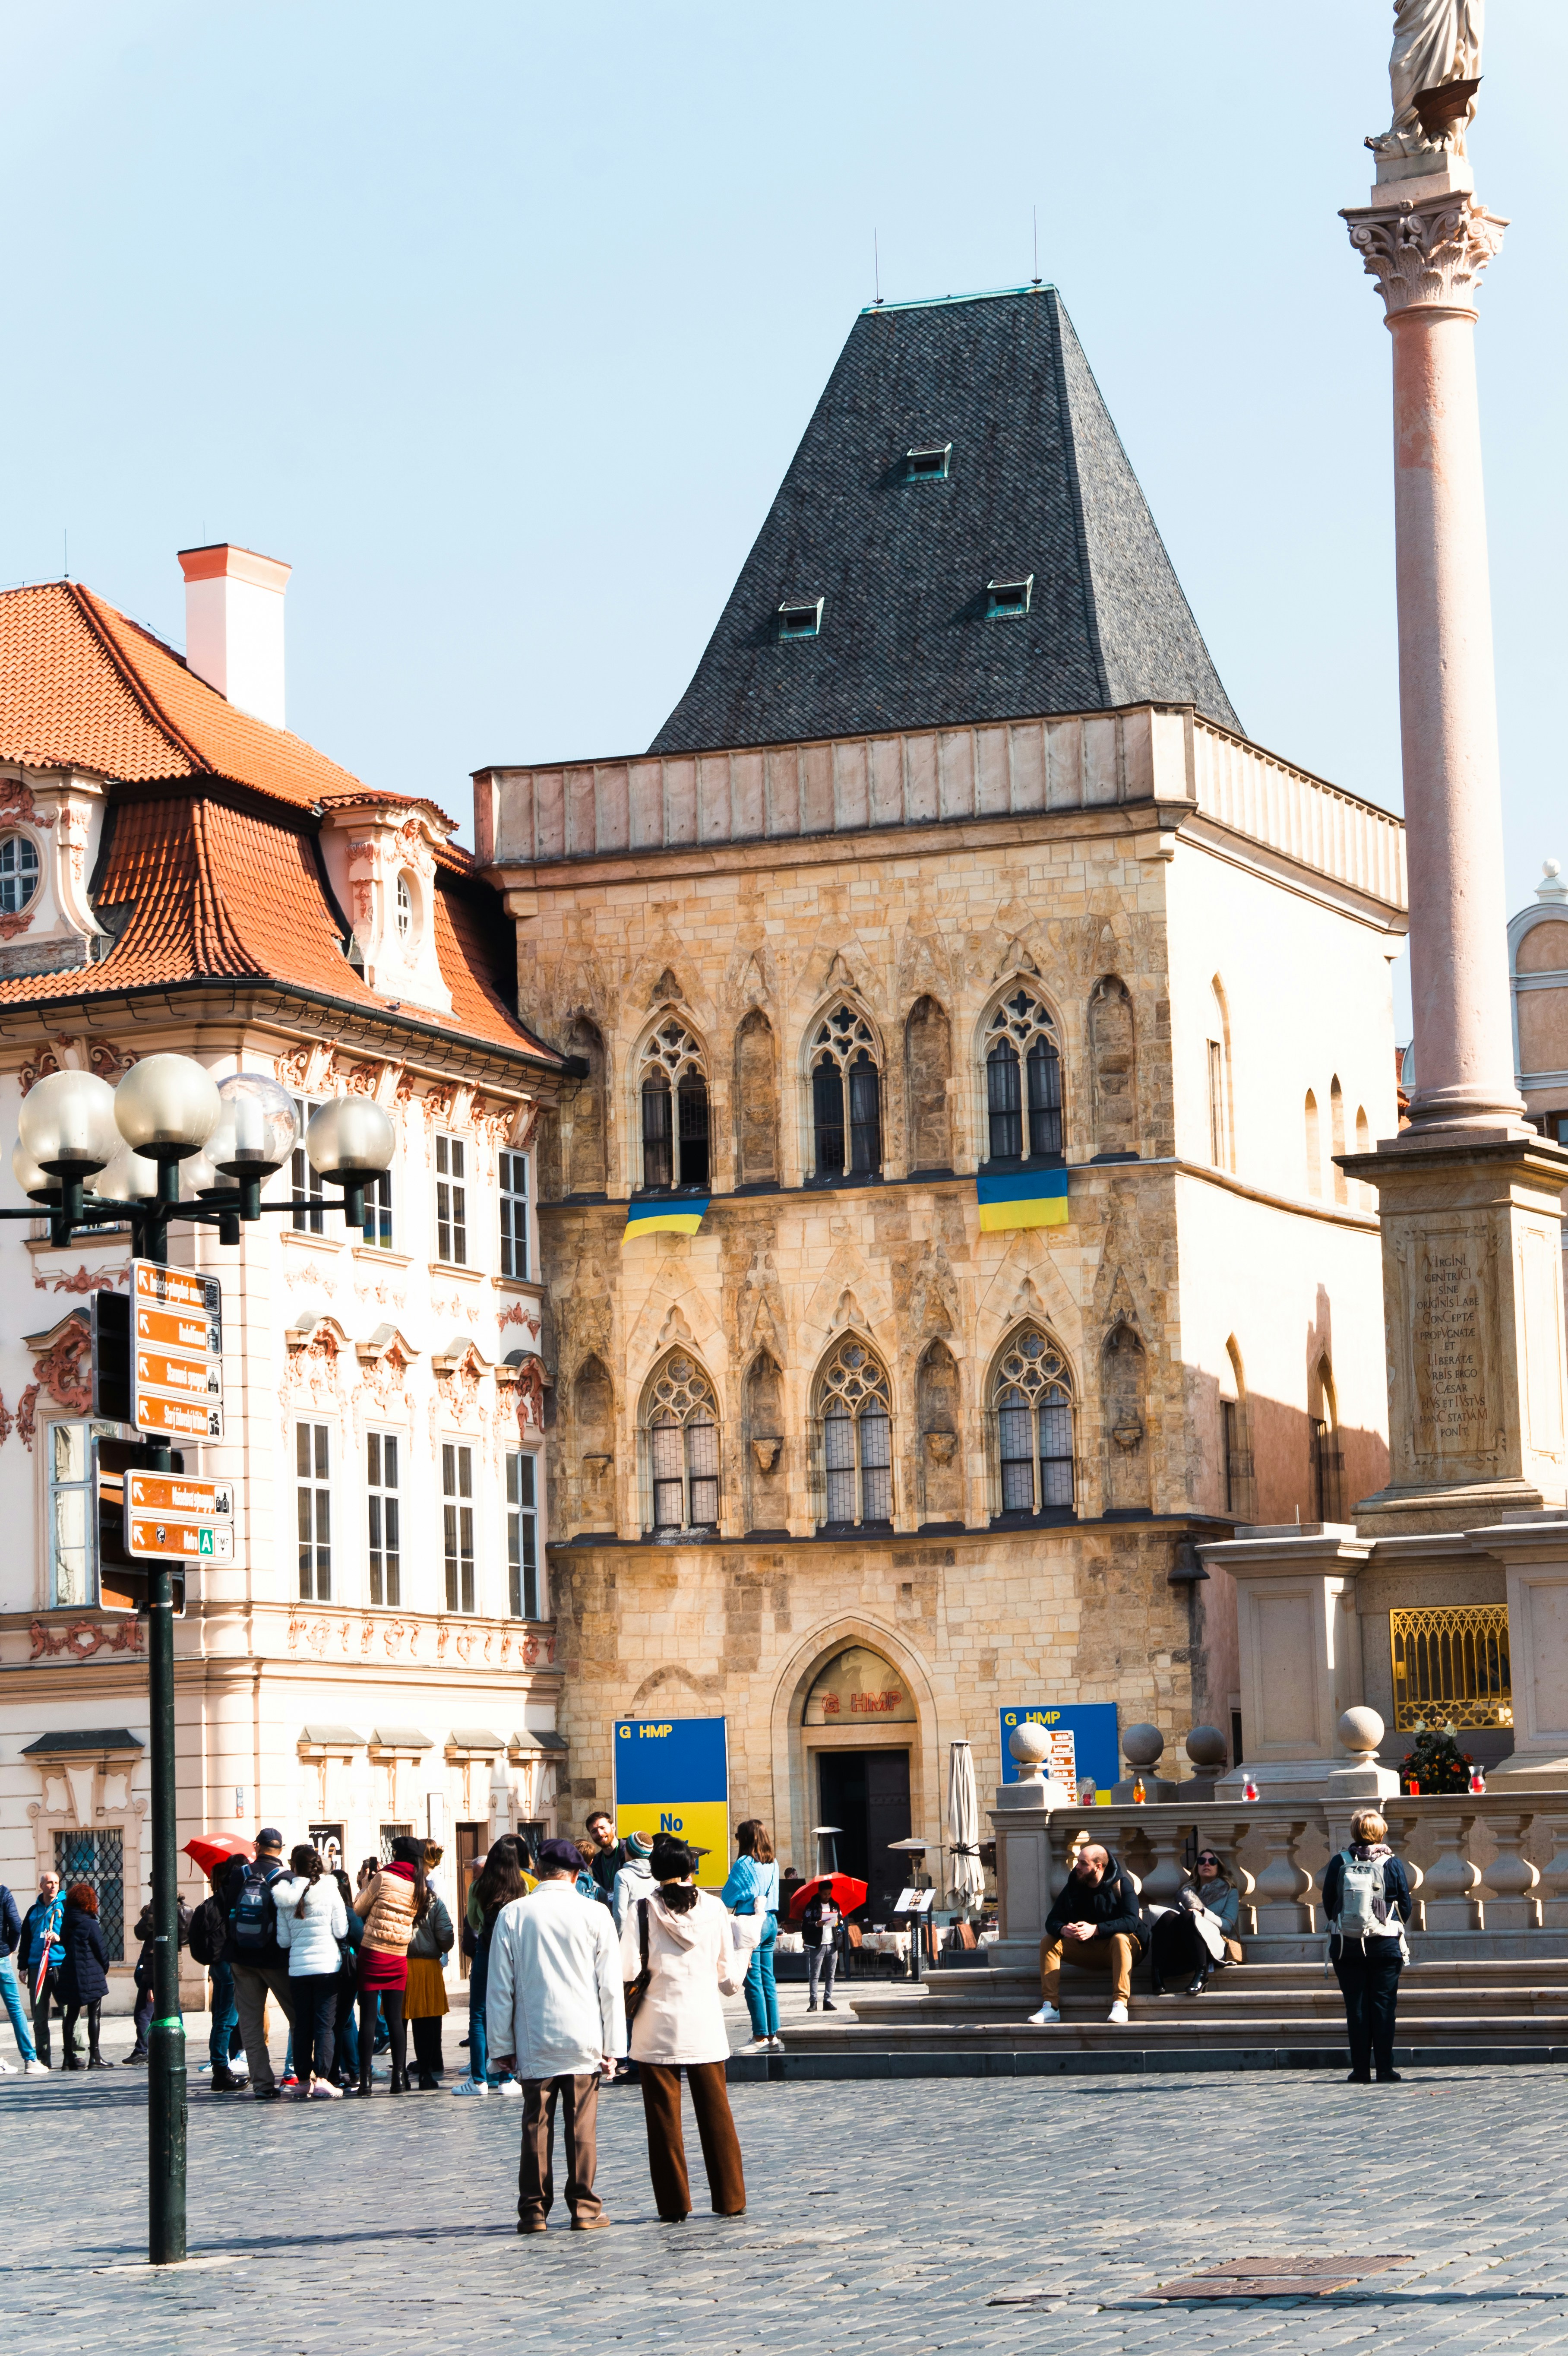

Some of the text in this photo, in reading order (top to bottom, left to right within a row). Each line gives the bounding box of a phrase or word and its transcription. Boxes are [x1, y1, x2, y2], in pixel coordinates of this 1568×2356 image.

[1438, 1283, 1459, 1295] SINE
[1445, 1342, 1455, 1350] ET
[1455, 1369, 1477, 1378] ERGO
[1443, 1399, 1453, 1408] ET
[1441, 1424, 1468, 1437] PONIT
[183, 1530, 212, 1552] Metro A
[822, 1691, 902, 1713] G HMP
[1005, 1711, 1061, 1726] G HMP
[620, 1724, 673, 1738] G HMP
[661, 1813, 683, 1831] No
